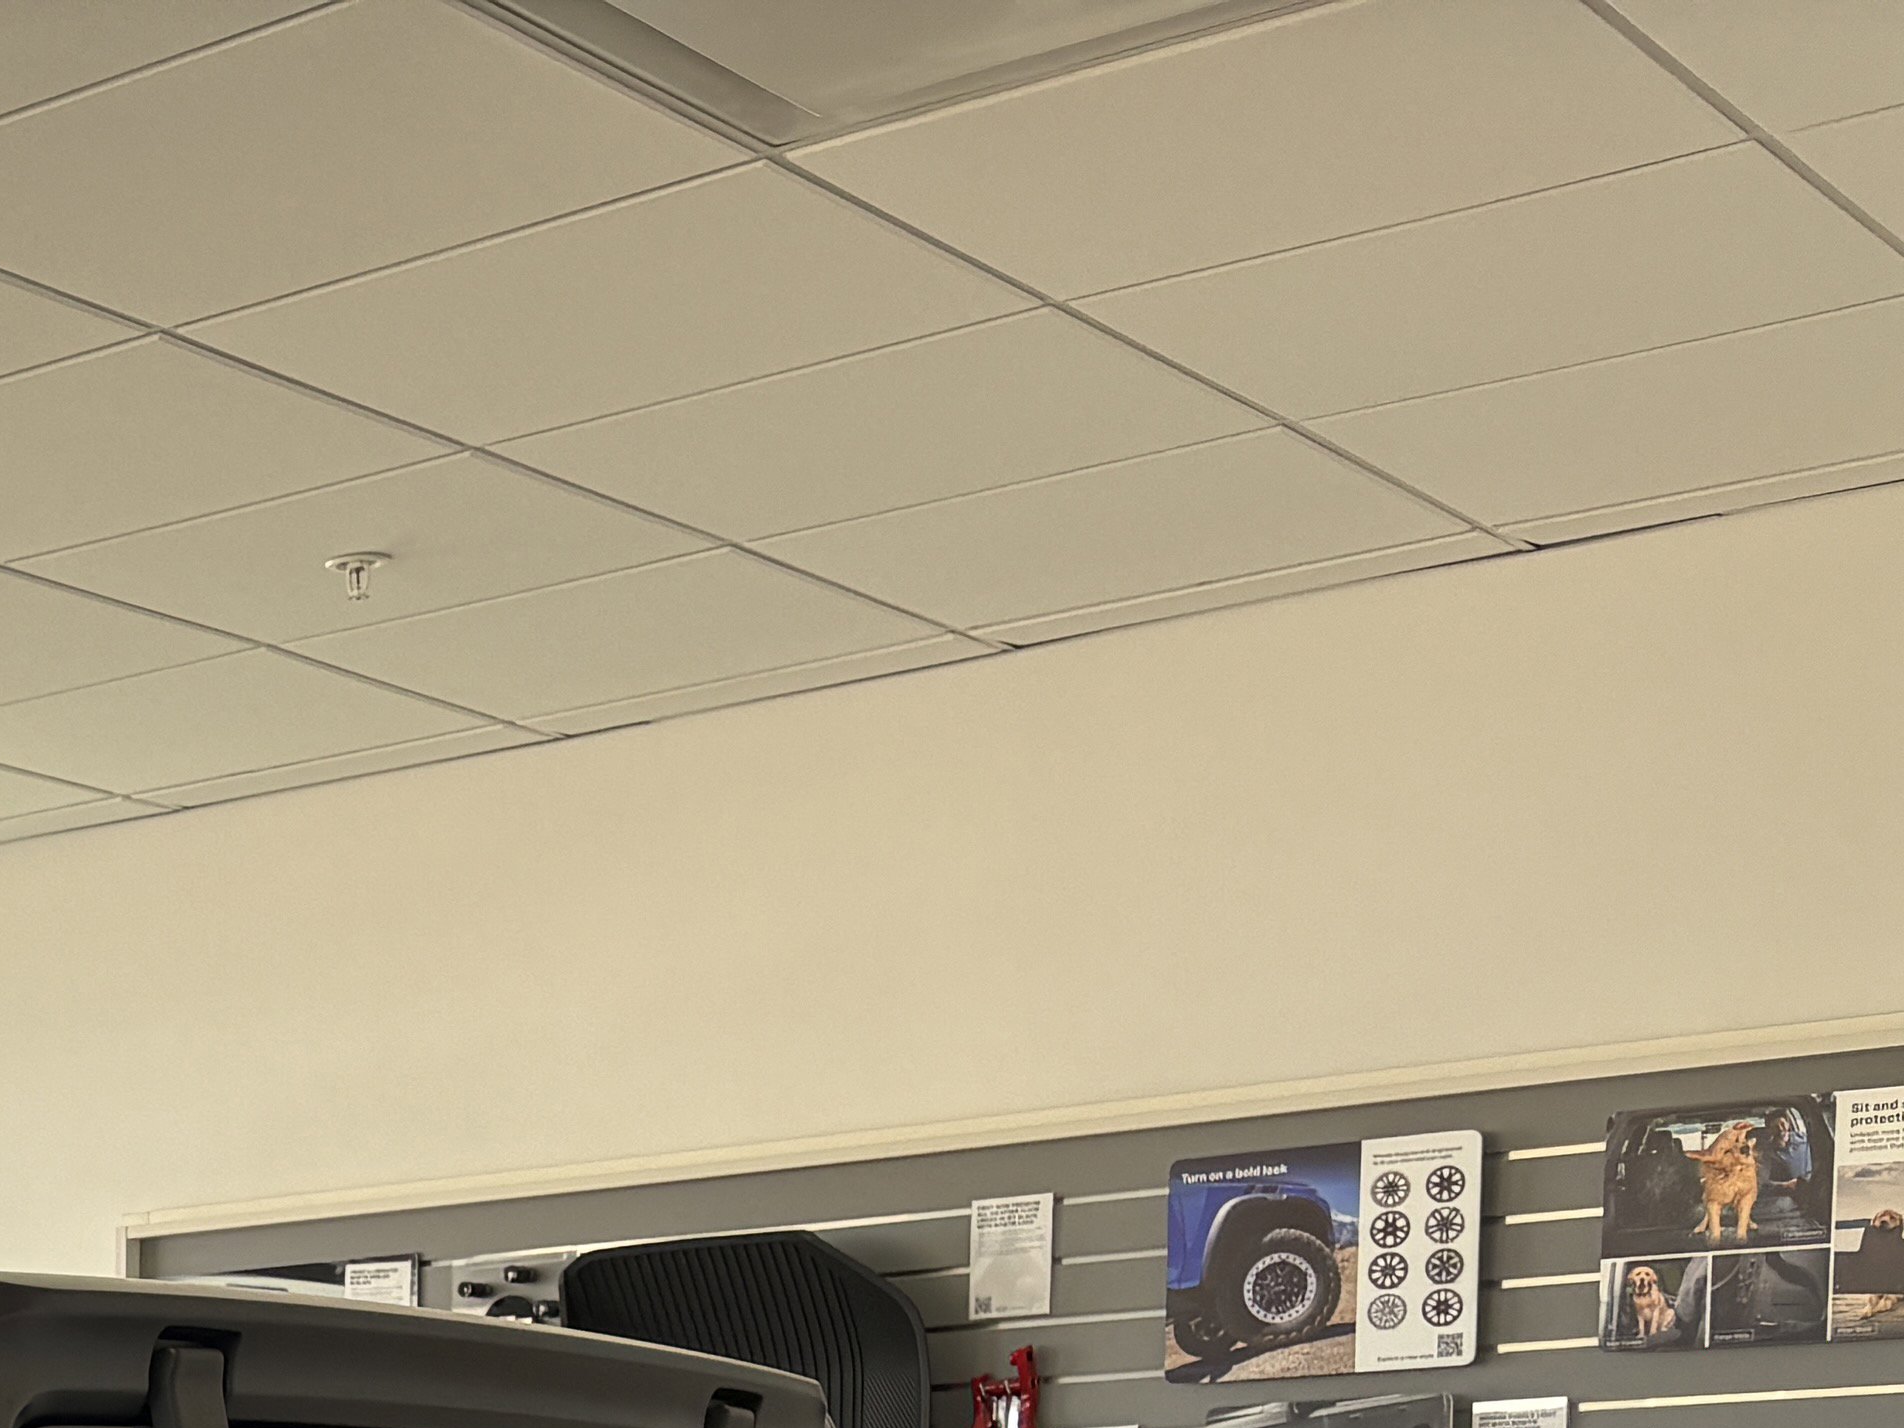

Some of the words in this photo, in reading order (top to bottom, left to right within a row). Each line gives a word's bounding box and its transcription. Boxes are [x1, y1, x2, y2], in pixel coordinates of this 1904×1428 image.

[1852, 1103, 1870, 1113] Sit
[1873, 1099, 1898, 1111] and
[1182, 1173, 1207, 1184] Turn
[1208, 1171, 1223, 1182] on
